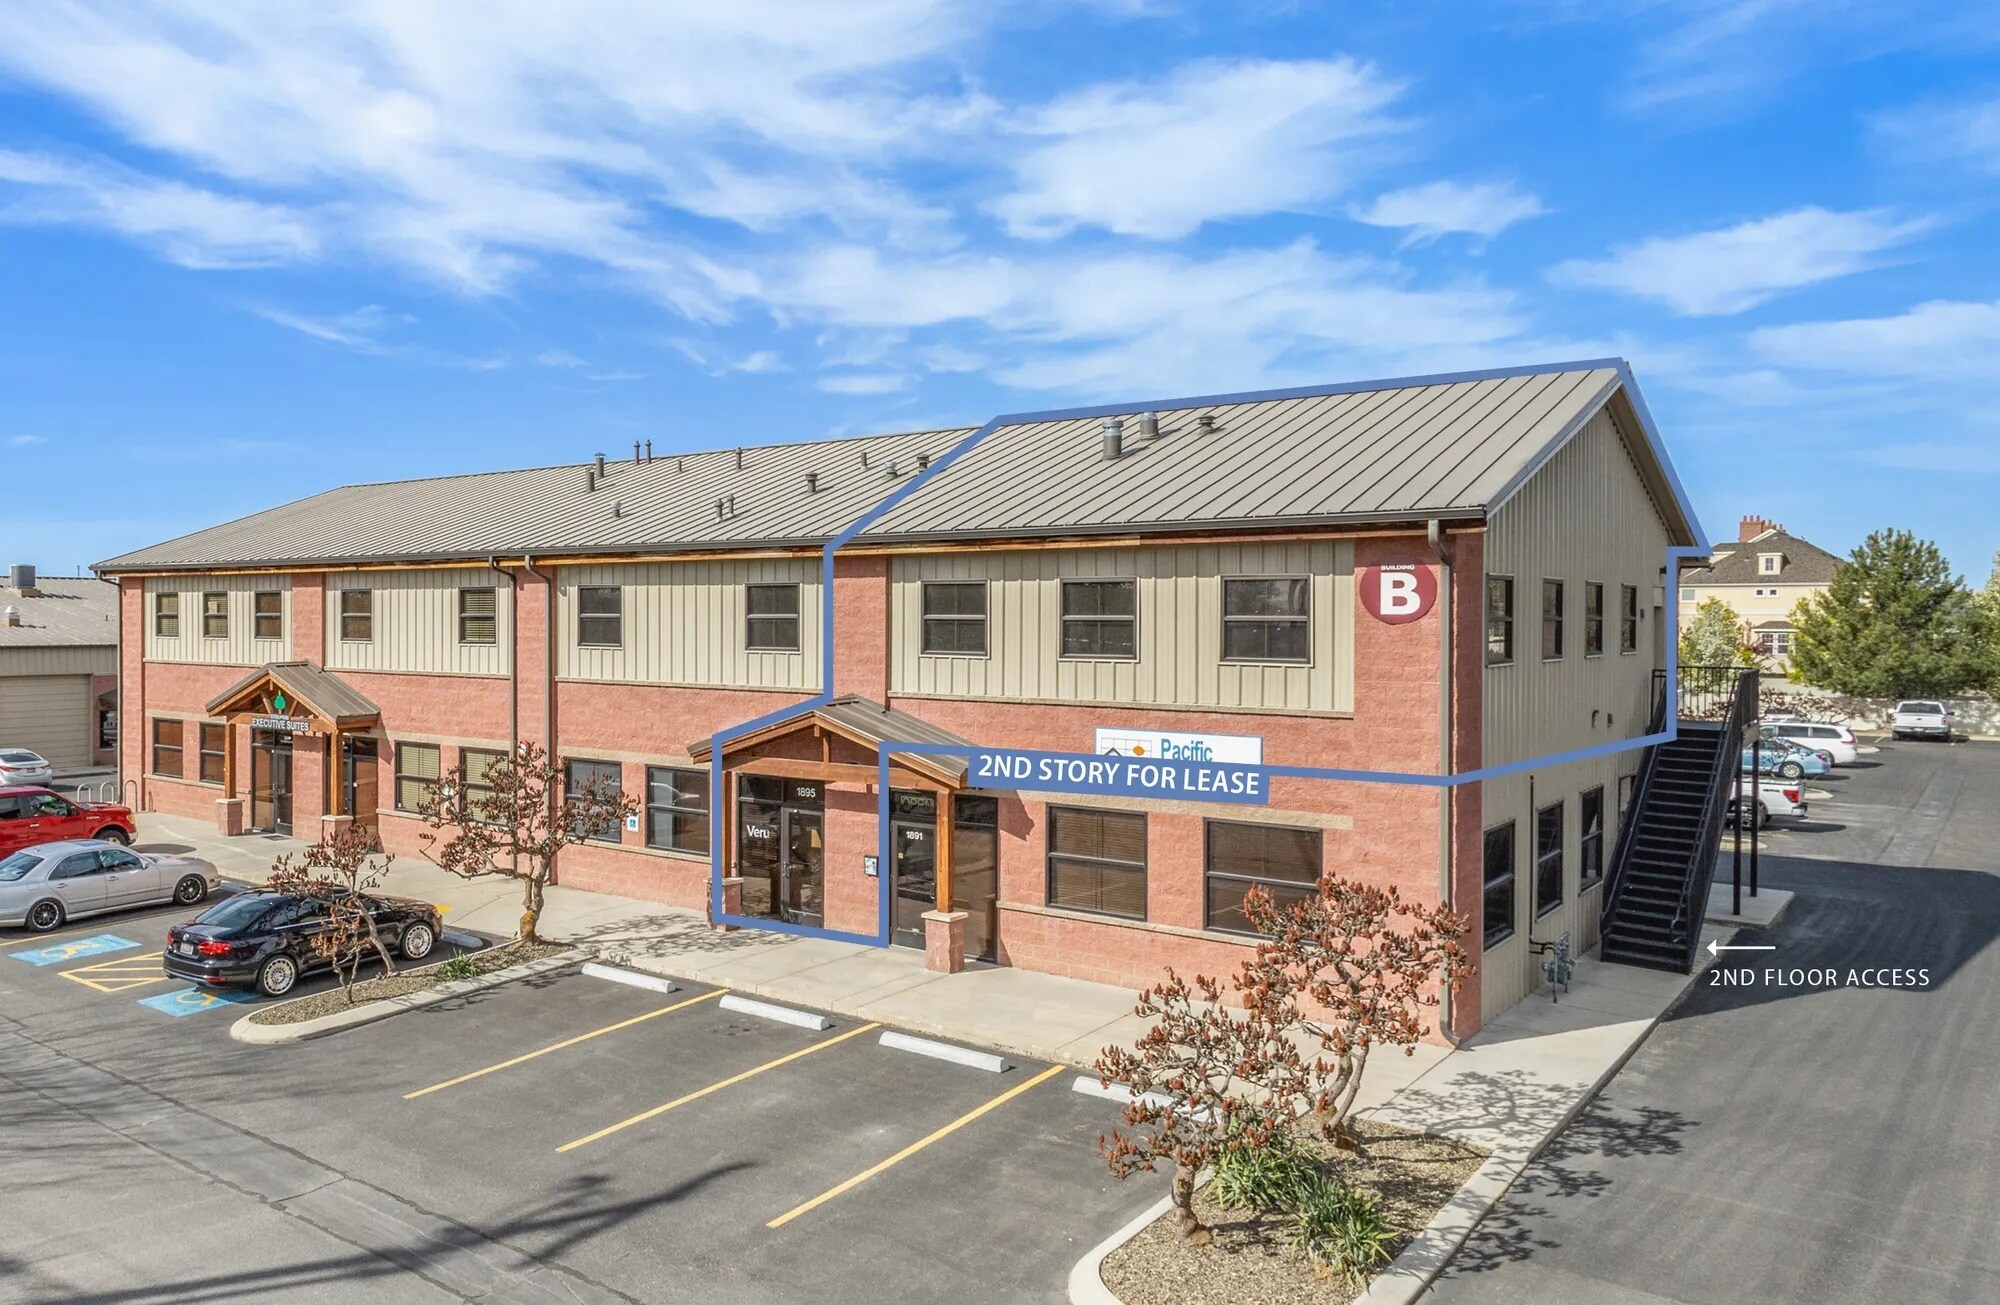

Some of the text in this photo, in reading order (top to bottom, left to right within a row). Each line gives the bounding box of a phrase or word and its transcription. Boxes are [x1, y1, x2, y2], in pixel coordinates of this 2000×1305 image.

[1380, 572, 1421, 615] B
[252, 718, 309, 731] EXECUTIVE SUITES
[796, 787, 816, 797] 1895
[906, 831, 923, 840] 1891
